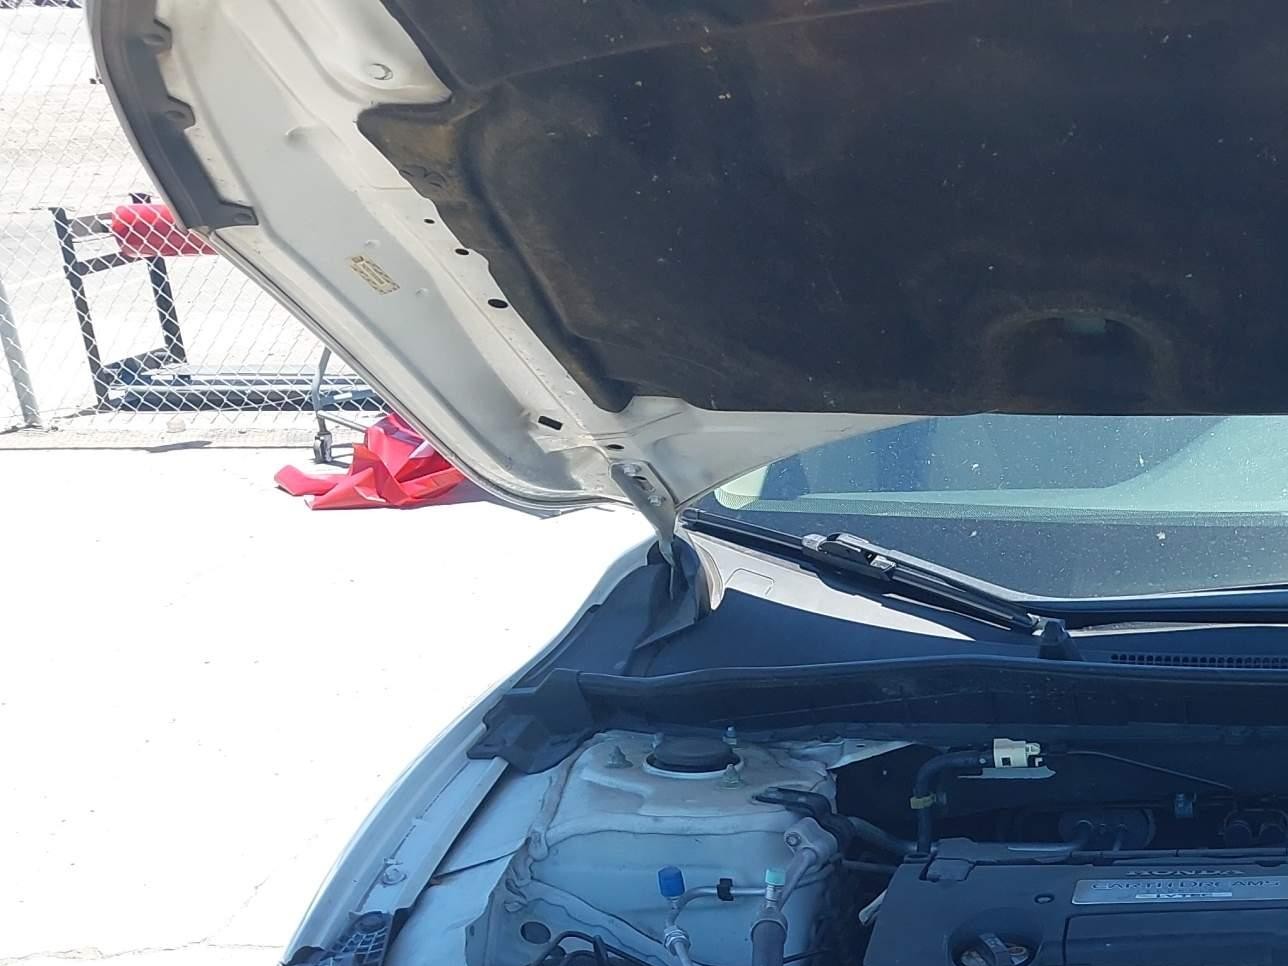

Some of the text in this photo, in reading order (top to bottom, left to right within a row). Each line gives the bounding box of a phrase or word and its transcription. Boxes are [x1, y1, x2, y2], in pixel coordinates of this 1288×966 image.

[1125, 868, 1245, 877] HONDA
[1090, 879, 1281, 890] EARTH DREAMS
